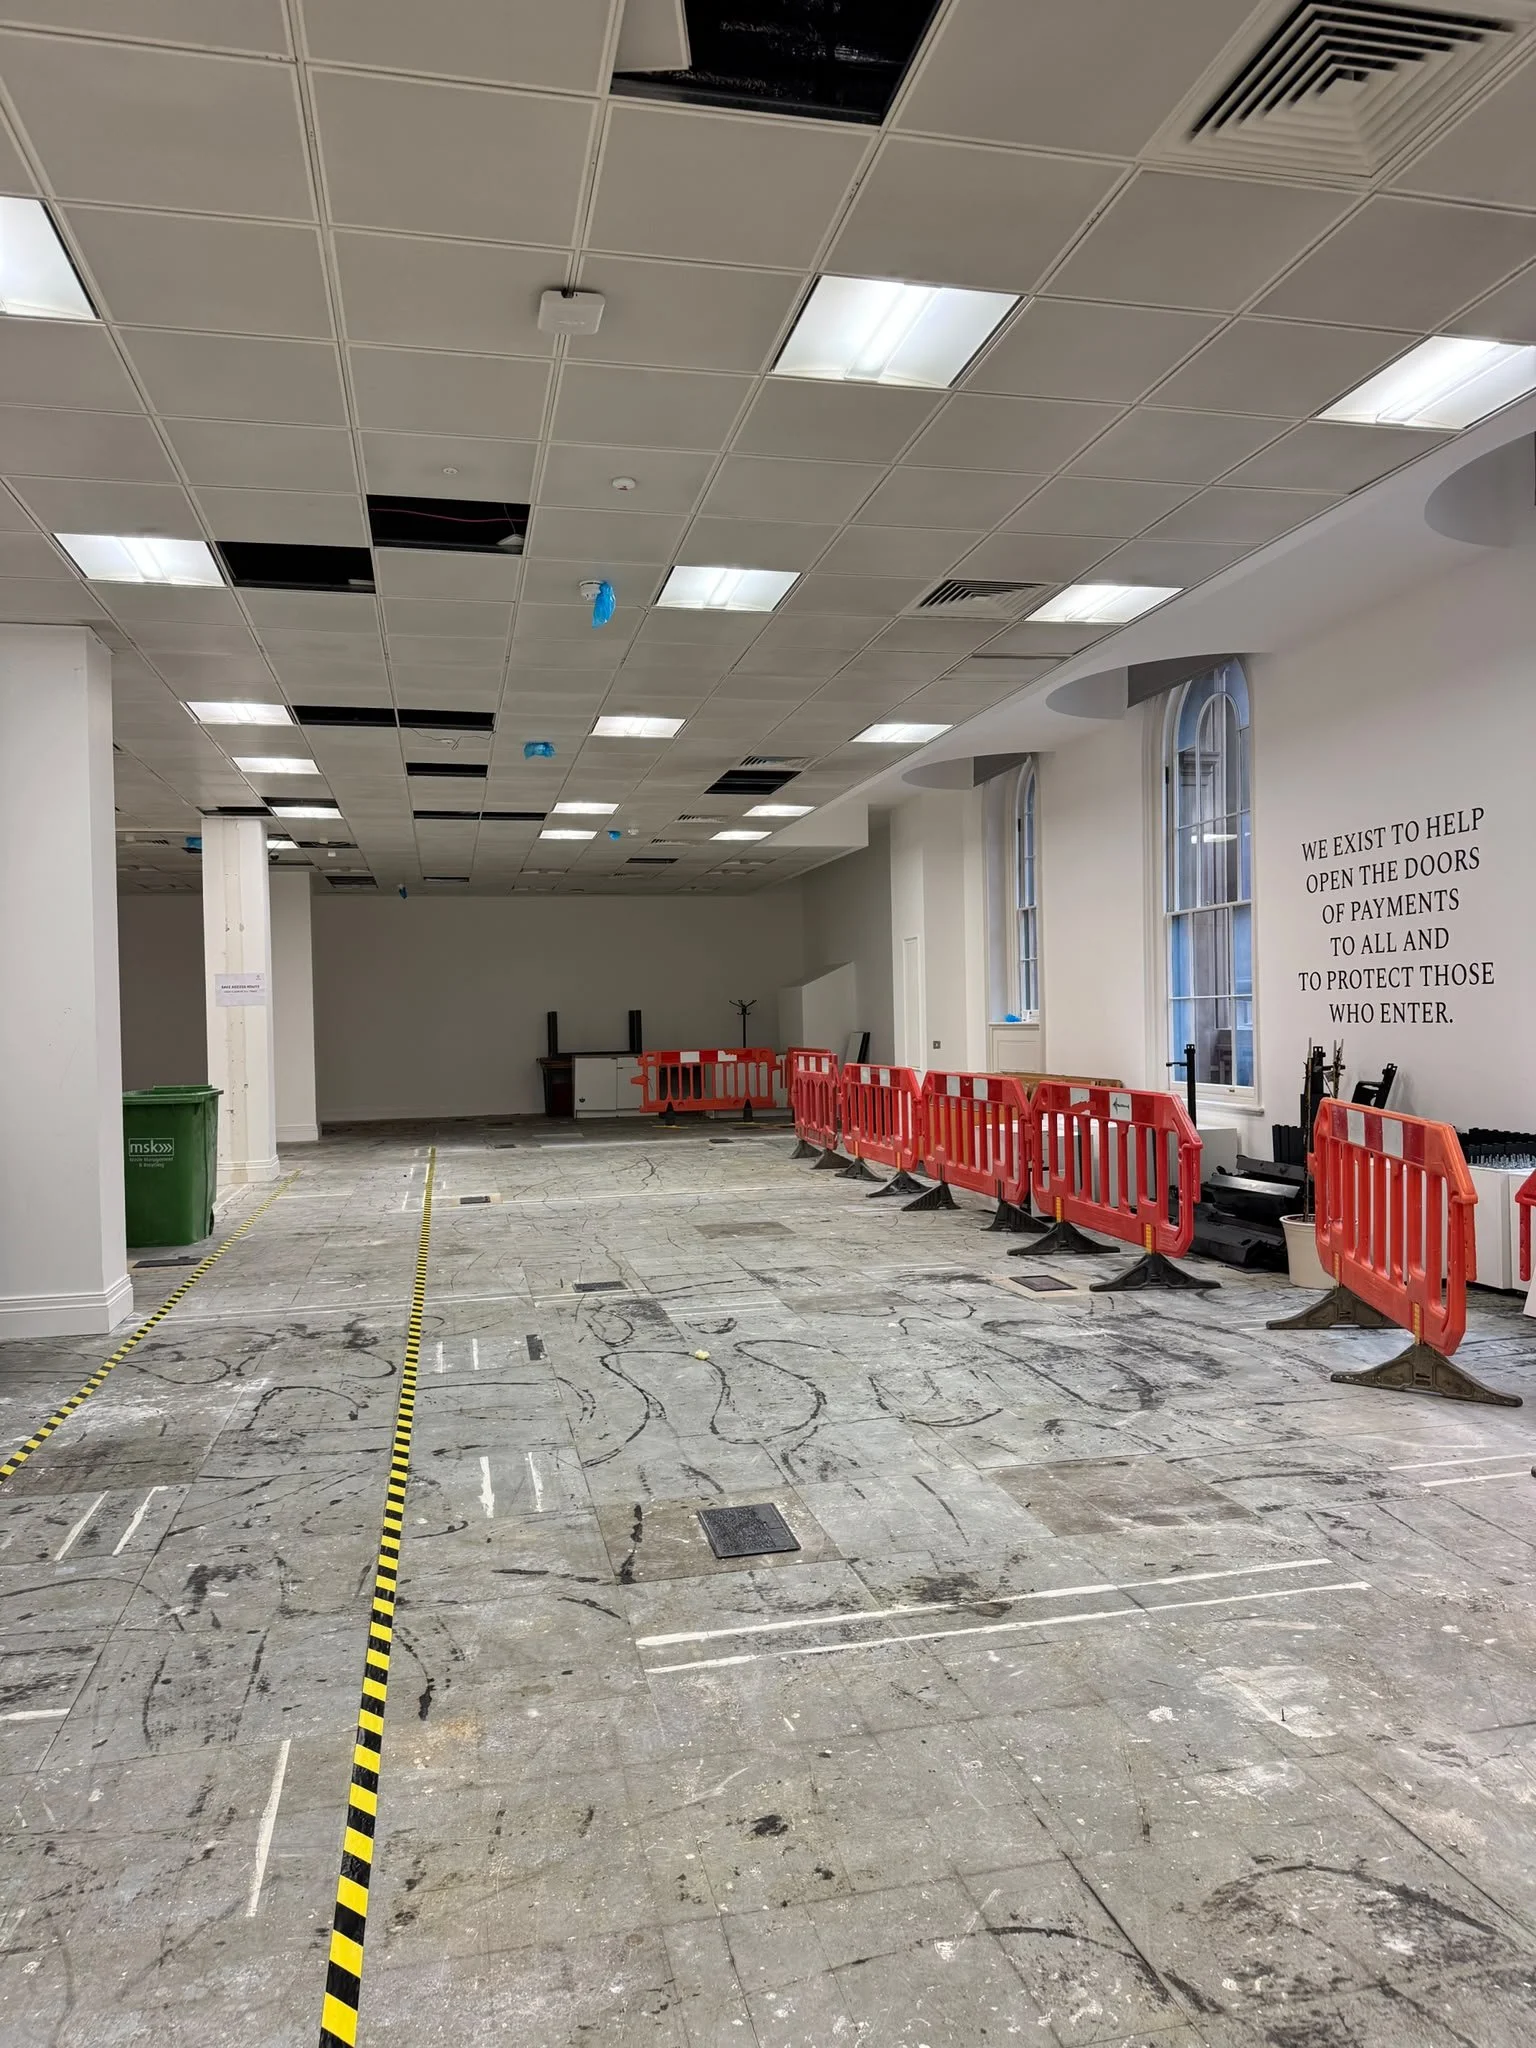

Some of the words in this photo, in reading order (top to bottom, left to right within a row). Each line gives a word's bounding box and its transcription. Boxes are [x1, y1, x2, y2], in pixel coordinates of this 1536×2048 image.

[1302, 839, 1328, 862] WE
[1333, 827, 1386, 857] EXIST
[1391, 820, 1420, 846] TO
[1426, 807, 1485, 840] HELP
[1306, 868, 1354, 894] OPEN
[1359, 860, 1399, 886] THE
[1404, 846, 1480, 880] DOORS
[1322, 903, 1345, 925] OF
[1351, 887, 1460, 922] PAYMENTS
[1330, 935, 1356, 957] TO
[1361, 931, 1397, 955] ALL
[1402, 927, 1450, 952] AND
[1298, 971, 1322, 992] TO
[1327, 965, 1414, 992] PROTECT
[1420, 961, 1495, 987] THOSE
[1329, 1002, 1375, 1024] WHO
[1380, 1001, 1454, 1024] ENTER.
